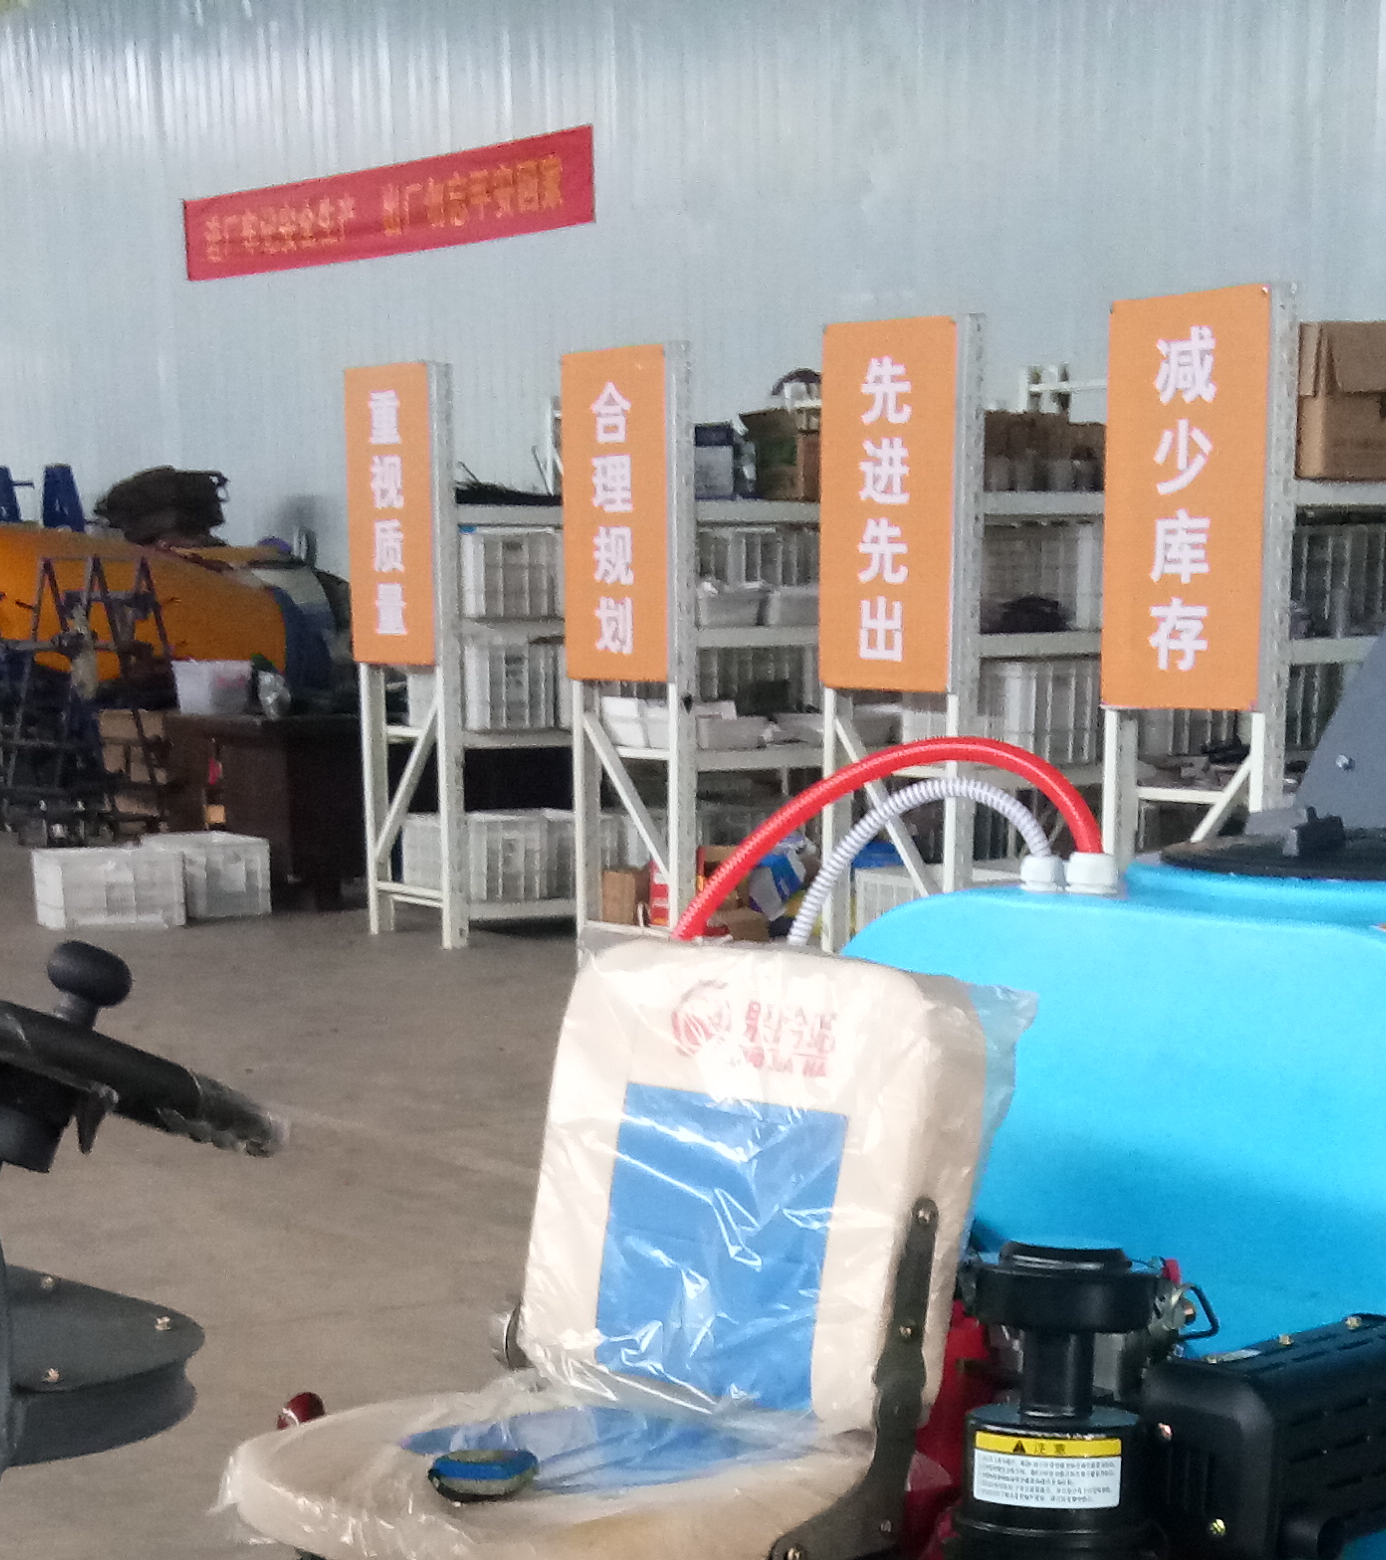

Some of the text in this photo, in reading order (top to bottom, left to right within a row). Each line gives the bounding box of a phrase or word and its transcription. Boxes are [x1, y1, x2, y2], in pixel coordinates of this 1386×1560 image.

[367, 389, 408, 636] 重视质量
[591, 381, 634, 655] 合理规划
[857, 355, 912, 662] 先进先出
[1149, 325, 1217, 672] 减少库存
